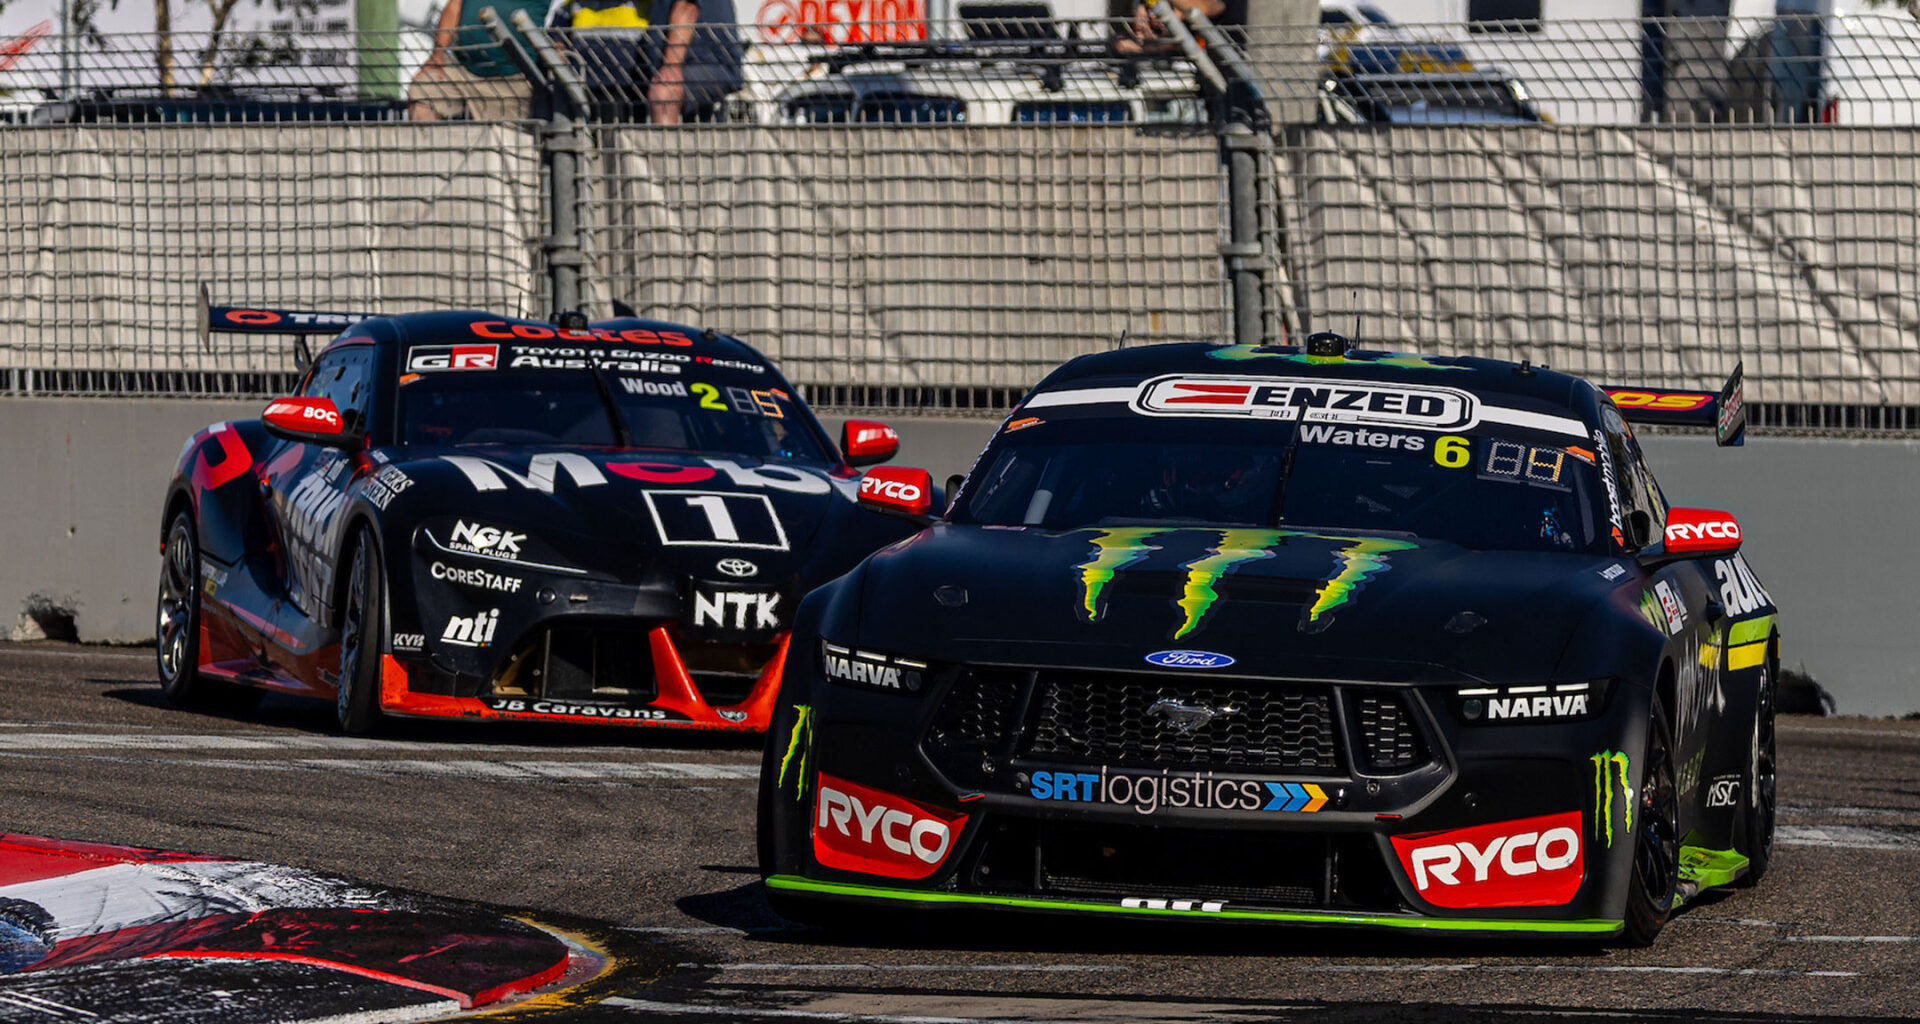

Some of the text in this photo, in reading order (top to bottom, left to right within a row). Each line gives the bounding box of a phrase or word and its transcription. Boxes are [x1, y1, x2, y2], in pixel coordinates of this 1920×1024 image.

[469, 321, 693, 346] Coates
[411, 353, 494, 369] GR
[510, 355, 681, 374] Australia
[511, 346, 765, 374] TOYOTA GAZOO Racing
[619, 377, 729, 412] Wood 2
[1251, 385, 1445, 418] ENZED
[303, 406, 338, 423] BOC
[1300, 424, 1470, 468] Waters 6
[860, 476, 920, 501] RYCO
[1593, 429, 1623, 531] boostmobile
[684, 496, 739, 541] 1
[1665, 521, 1740, 541] RYCO
[450, 519, 527, 552] NGK
[449, 541, 518, 560] SPARK PLUGS
[694, 589, 781, 630] NTK
[442, 608, 500, 643] nti
[393, 633, 426, 647] KYB
[825, 655, 900, 688] NARVA
[1162, 652, 1217, 666] Ford
[493, 699, 667, 720] JB Caravans
[1487, 694, 1588, 719] NARVA
[818, 786, 950, 864] RYCO
[1411, 827, 1579, 891] RYCO
